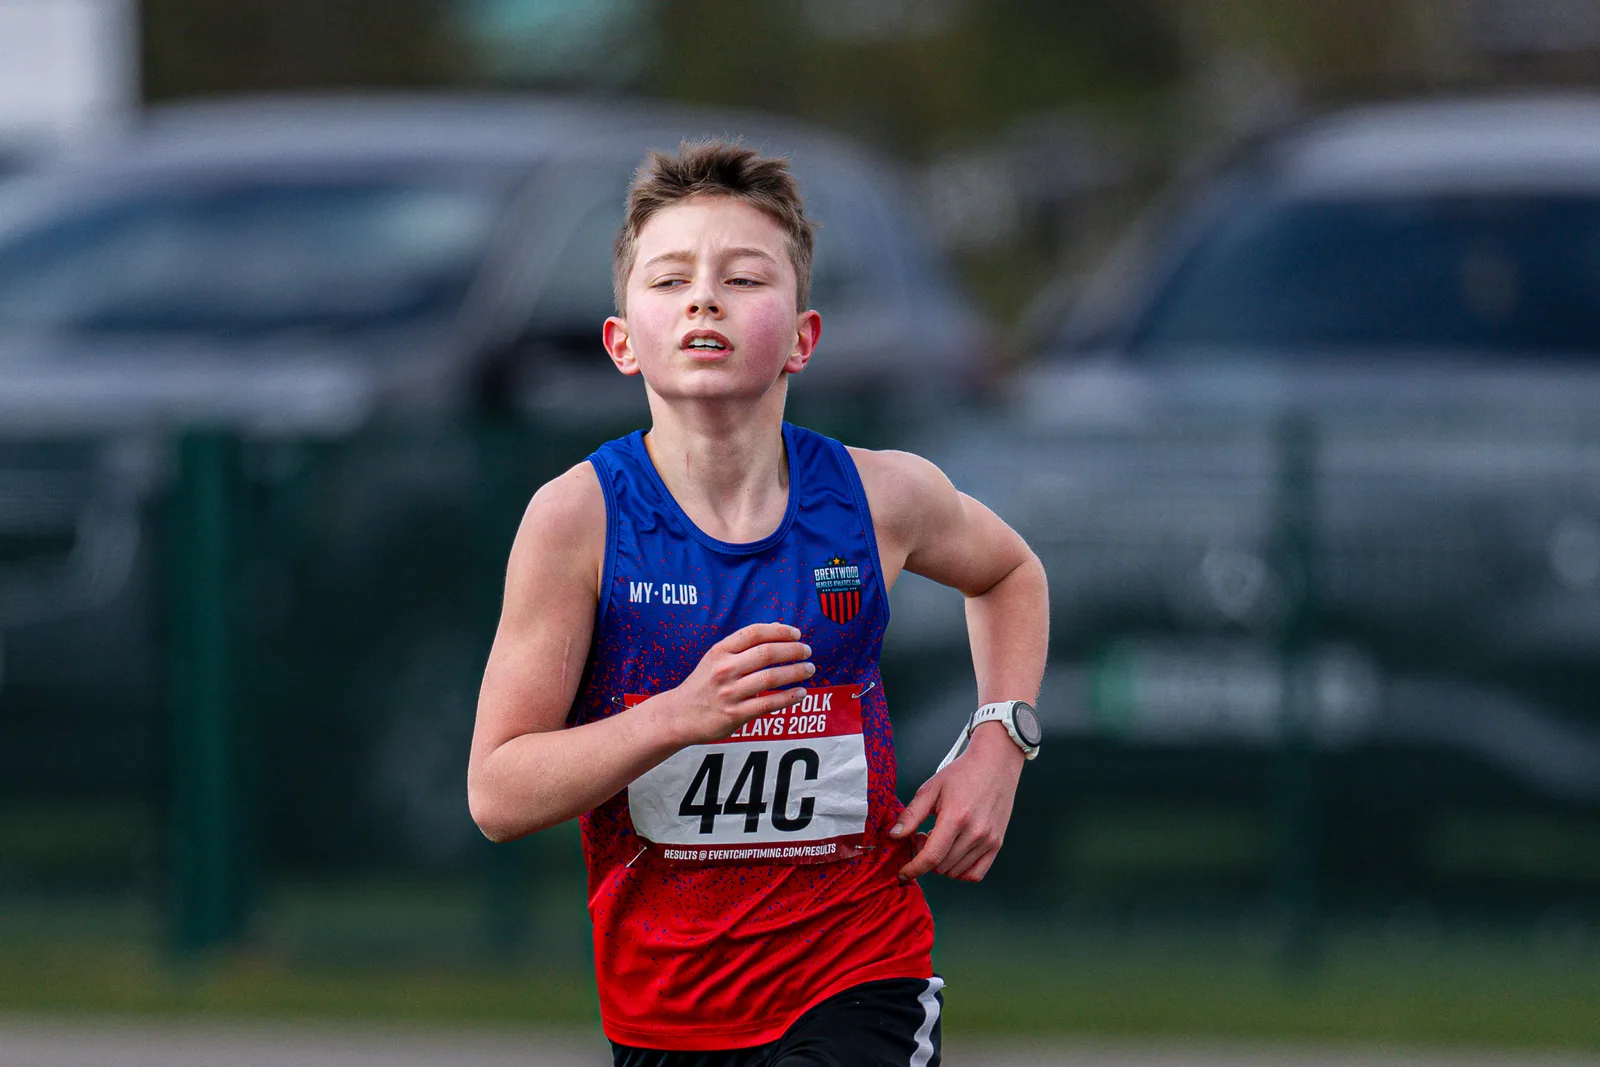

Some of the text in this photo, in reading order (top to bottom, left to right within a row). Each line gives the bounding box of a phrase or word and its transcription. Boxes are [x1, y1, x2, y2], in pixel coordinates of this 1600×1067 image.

[814, 566, 859, 581] BRENTWOOD
[731, 714, 827, 738] LAYS 2026
[678, 747, 820, 834] 44C
[664, 843, 837, 861] RESULTS @ EVENTCHIPTIMING.COM/RESULTS
